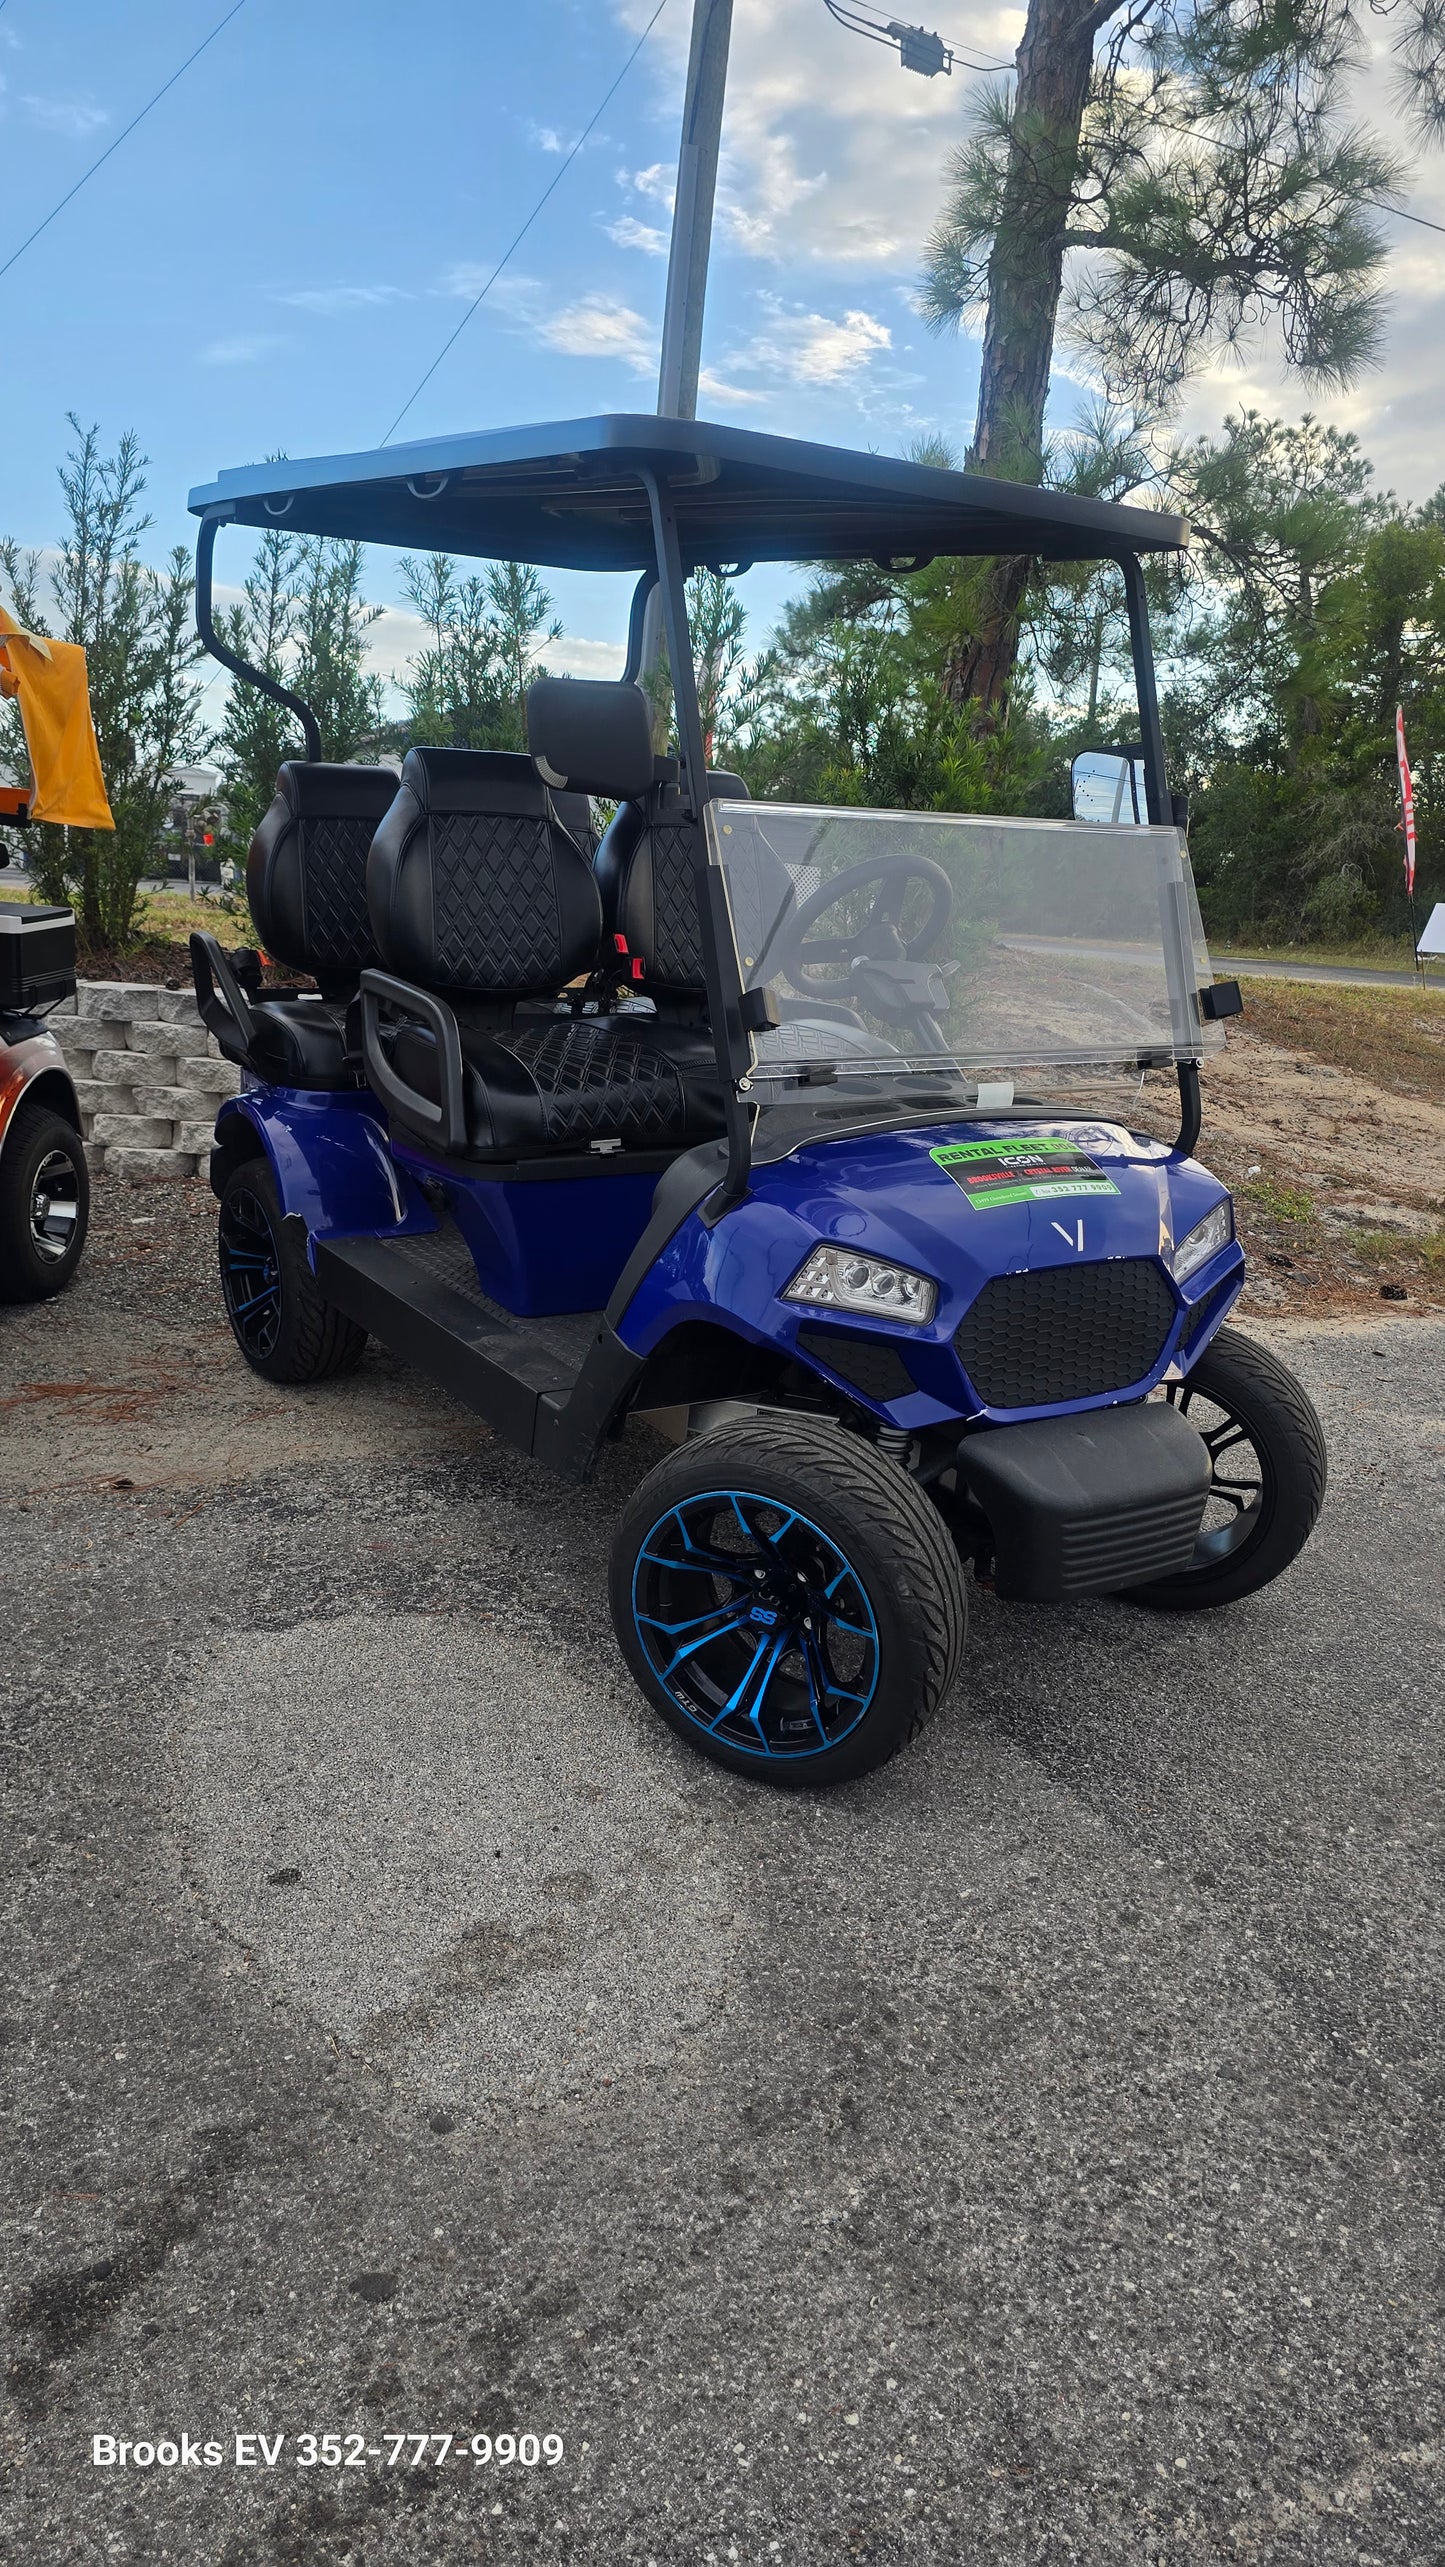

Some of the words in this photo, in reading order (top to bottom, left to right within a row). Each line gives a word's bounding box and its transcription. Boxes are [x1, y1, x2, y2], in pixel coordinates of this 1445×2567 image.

[936, 1146, 1004, 1162] RENTAL
[1002, 1143, 1050, 1154] FLEET
[997, 1154, 1045, 1167] ICON
[966, 1170, 1016, 1184] BROOKSVILLE
[1051, 1185, 1070, 1193] 352
[1071, 1184, 1088, 1192] 777
